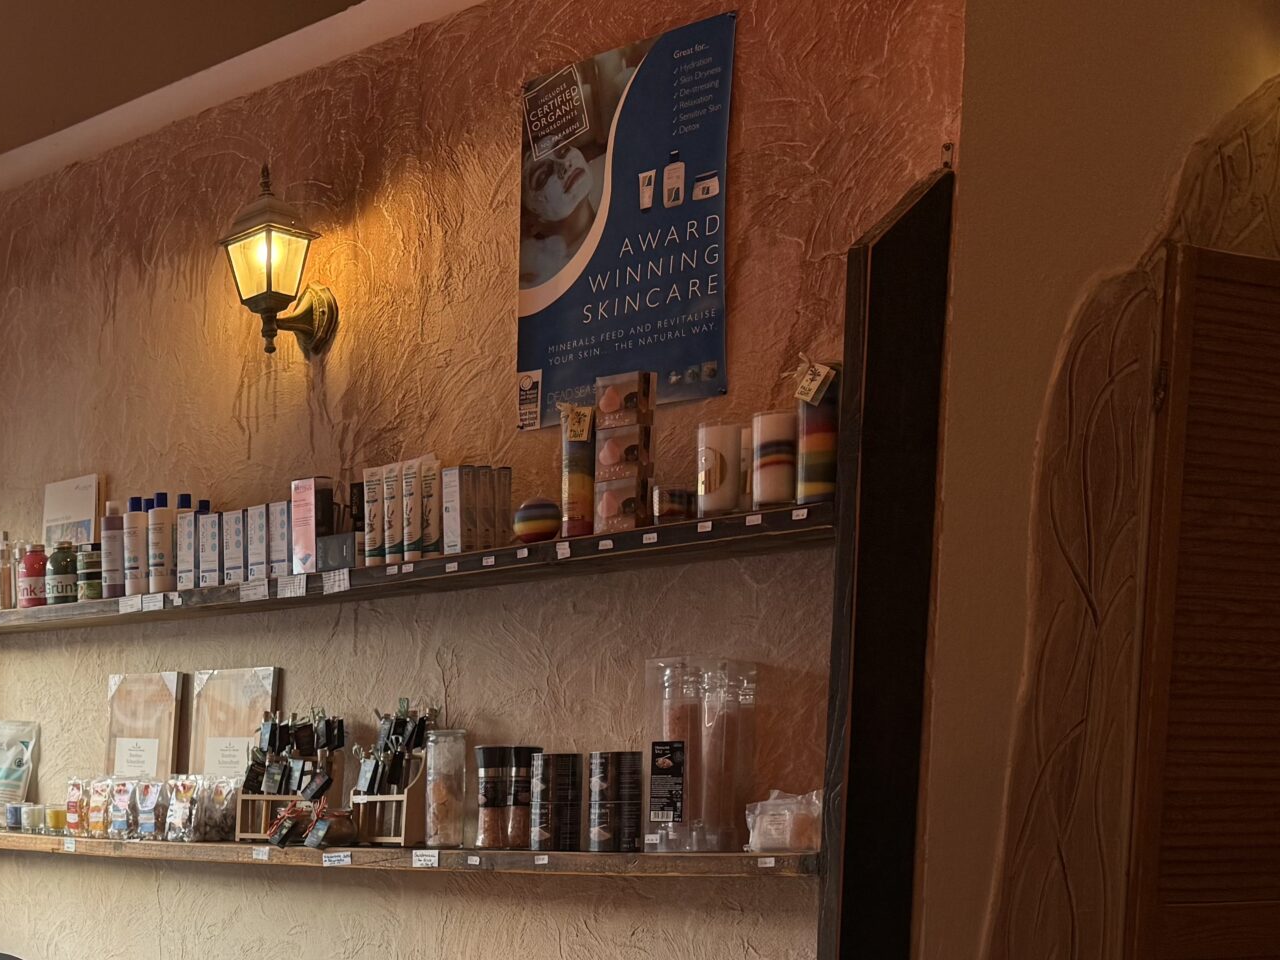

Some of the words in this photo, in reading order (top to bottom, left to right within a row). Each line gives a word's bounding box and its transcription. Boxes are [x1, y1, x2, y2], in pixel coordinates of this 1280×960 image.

[673, 47, 694, 60] Great
[680, 56, 713, 73] Hydration
[680, 74, 694, 86] Skin
[694, 66, 722, 81] Dryness
[530, 85, 578, 121] CERTIFIED
[538, 83, 567, 106] INCLUDES
[680, 94, 713, 110] Relaxation
[531, 95, 581, 131] ORGANIC
[538, 110, 578, 138] INGREDIENTS
[679, 107, 707, 122] Sensitive
[551, 121, 581, 143] PARABENS
[679, 123, 700, 136] Detox
[618, 214, 720, 259] AWARD
[588, 244, 719, 294] WINNING
[582, 273, 719, 324] SKINCARE
[548, 335, 596, 354] MINERALS
[600, 329, 624, 342] FEED
[629, 322, 652, 336] AND
[657, 308, 718, 330] REVITALISE
[548, 352, 574, 366] YOUR
[614, 339, 634, 351] THE
[638, 328, 687, 346] NATURAL
[546, 388, 573, 406] DEAD
[575, 384, 590, 399] SEA
[46, 580, 73, 596] Grün
